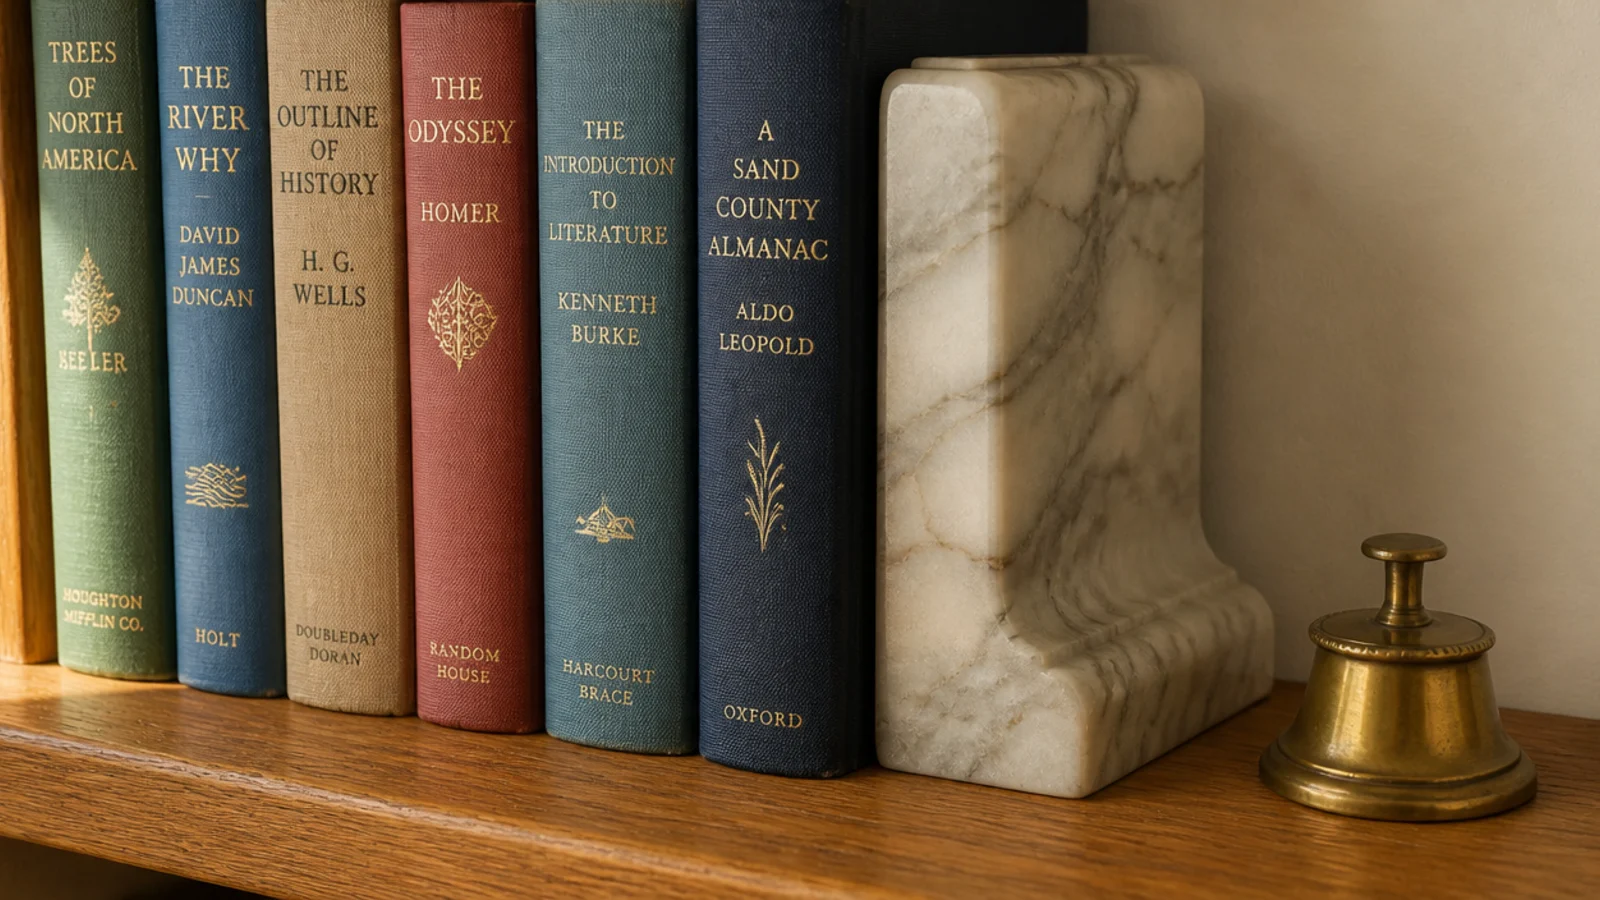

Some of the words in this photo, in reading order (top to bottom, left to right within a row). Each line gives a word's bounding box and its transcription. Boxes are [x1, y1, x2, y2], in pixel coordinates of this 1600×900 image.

[48, 41, 117, 64] TREES
[69, 77, 96, 98] OF
[179, 66, 230, 89] THE
[300, 69, 348, 92] THE
[431, 77, 483, 100] THE
[48, 112, 123, 134] NORTH
[167, 106, 250, 130] RIVER
[277, 105, 379, 128] OUTLINE
[408, 119, 516, 144] ODYSSEY
[583, 121, 625, 140] THE
[757, 120, 775, 141] A
[42, 148, 137, 171] AMERICA
[175, 147, 241, 173] WHY
[311, 139, 339, 160] OF
[544, 155, 676, 176] INTRODUCTION
[733, 159, 800, 180] SAND
[280, 171, 379, 196] HISTORY
[589, 191, 617, 210] TO
[716, 197, 820, 221] COUNTY
[421, 202, 501, 223] HOMER
[179, 226, 240, 245] DAVID
[549, 223, 668, 245] LITERATURE
[708, 237, 829, 261] ALMANAC
[179, 257, 240, 276] JAMES
[302, 250, 324, 272] H.
[333, 251, 354, 273] G.
[172, 287, 254, 307] DUNCAN
[293, 283, 366, 307] WELLS
[557, 292, 657, 314] KENNETH
[736, 303, 794, 322] ALDO
[572, 325, 640, 346] BURKE
[719, 333, 815, 356] LEOPOLD
[63, 588, 143, 610] HOUGHTON
[119, 616, 144, 632] CO.
[296, 624, 379, 646] DOUBLEDAY
[195, 628, 240, 648] HOLT
[309, 647, 362, 666] DORAN
[429, 641, 500, 662] RANDOM
[437, 664, 490, 684] HOUSE
[563, 659, 655, 684] HARCOURT
[579, 685, 634, 706] BRACE
[724, 705, 803, 729] OXFORD
